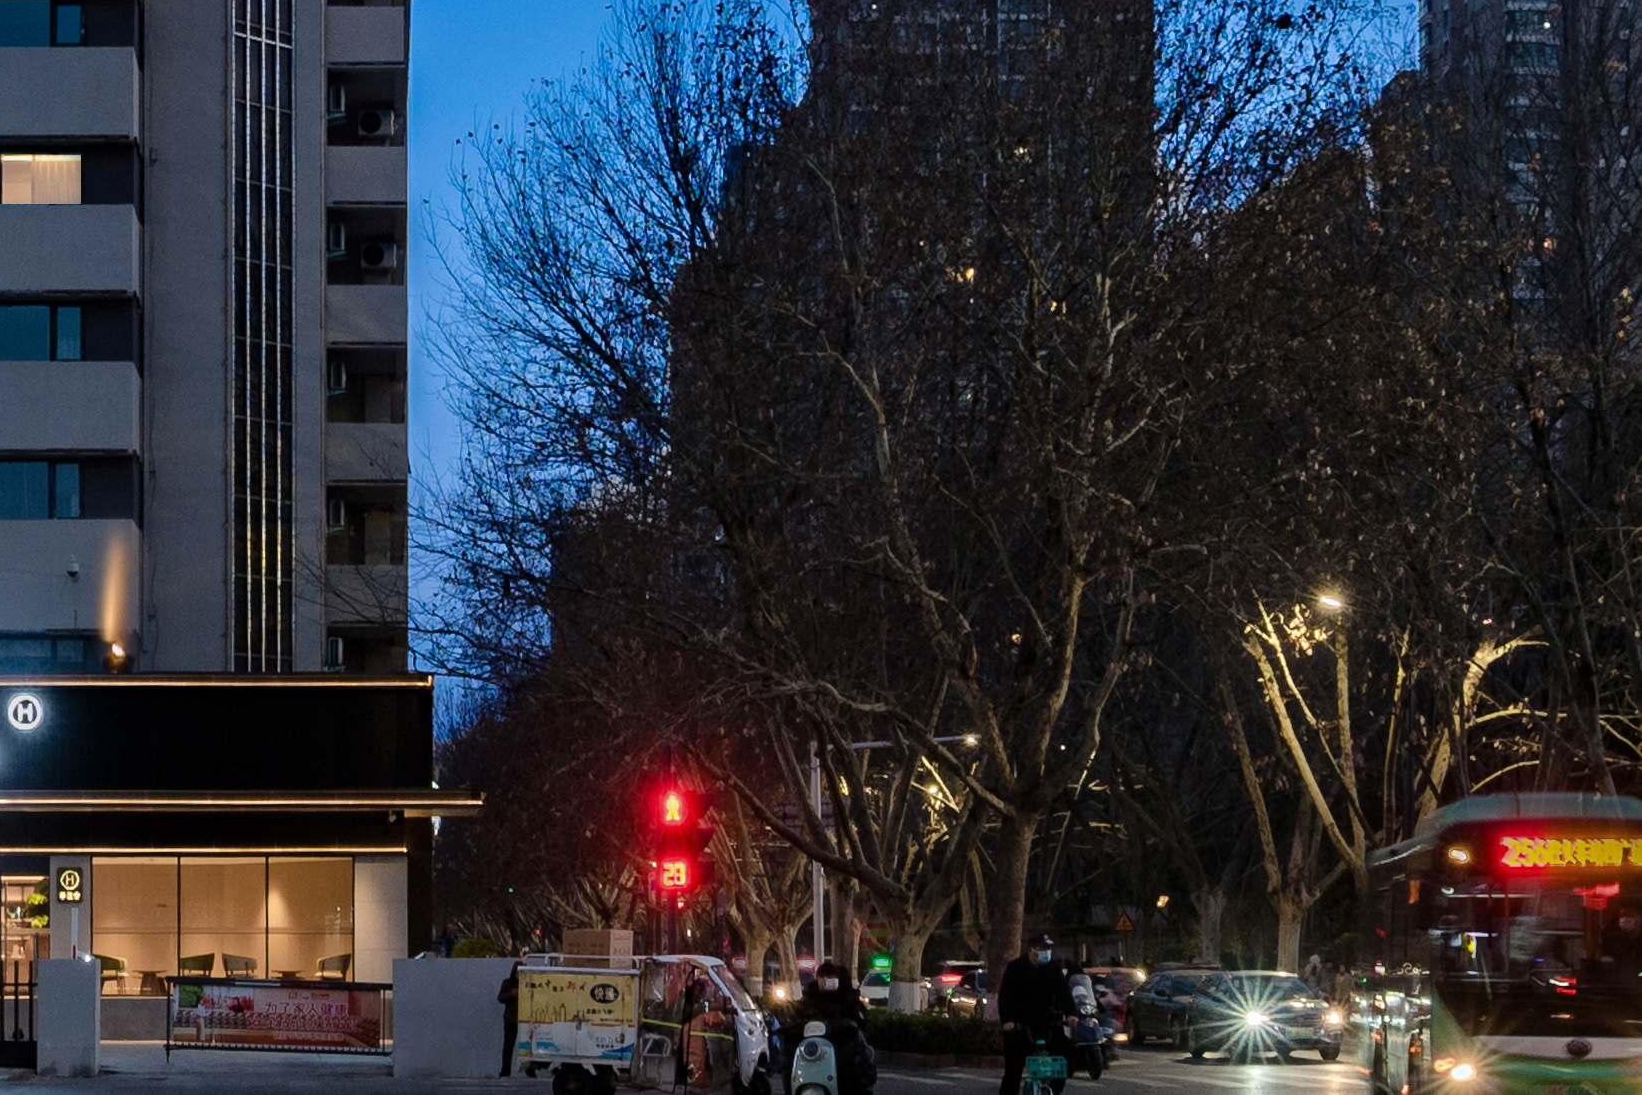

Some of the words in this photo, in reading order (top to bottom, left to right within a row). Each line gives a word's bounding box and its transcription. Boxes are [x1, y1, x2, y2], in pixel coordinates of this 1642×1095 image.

[264, 1000, 348, 1017] 为了家人健康
